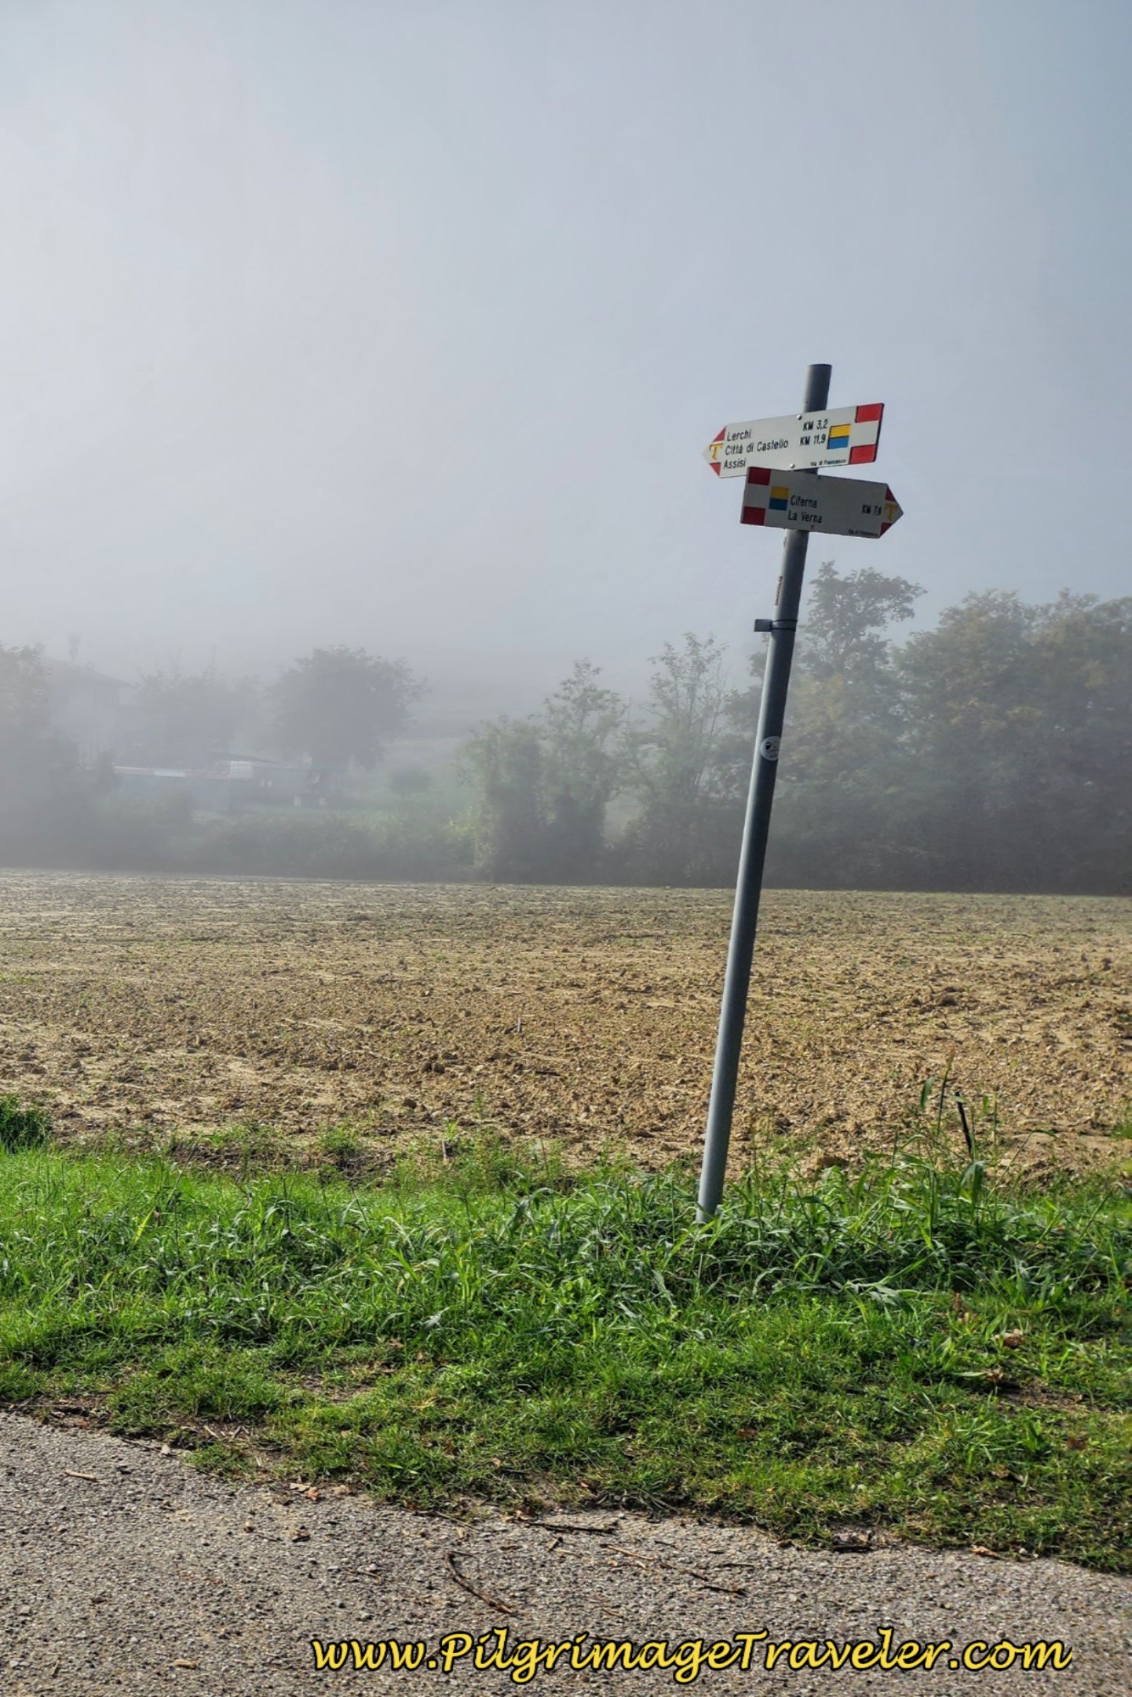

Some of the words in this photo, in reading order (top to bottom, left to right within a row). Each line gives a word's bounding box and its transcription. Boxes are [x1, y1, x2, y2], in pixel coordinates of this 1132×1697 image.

[726, 429, 752, 442] Lerchi
[802, 420, 814, 431] KM
[725, 444, 744, 456] Città
[746, 441, 754, 453] di
[757, 439, 789, 452] Castello
[799, 435, 811, 446] KM
[723, 457, 747, 470] Assisi
[790, 495, 817, 508] Citerna
[788, 510, 798, 521] La
[801, 511, 822, 523] Verna
